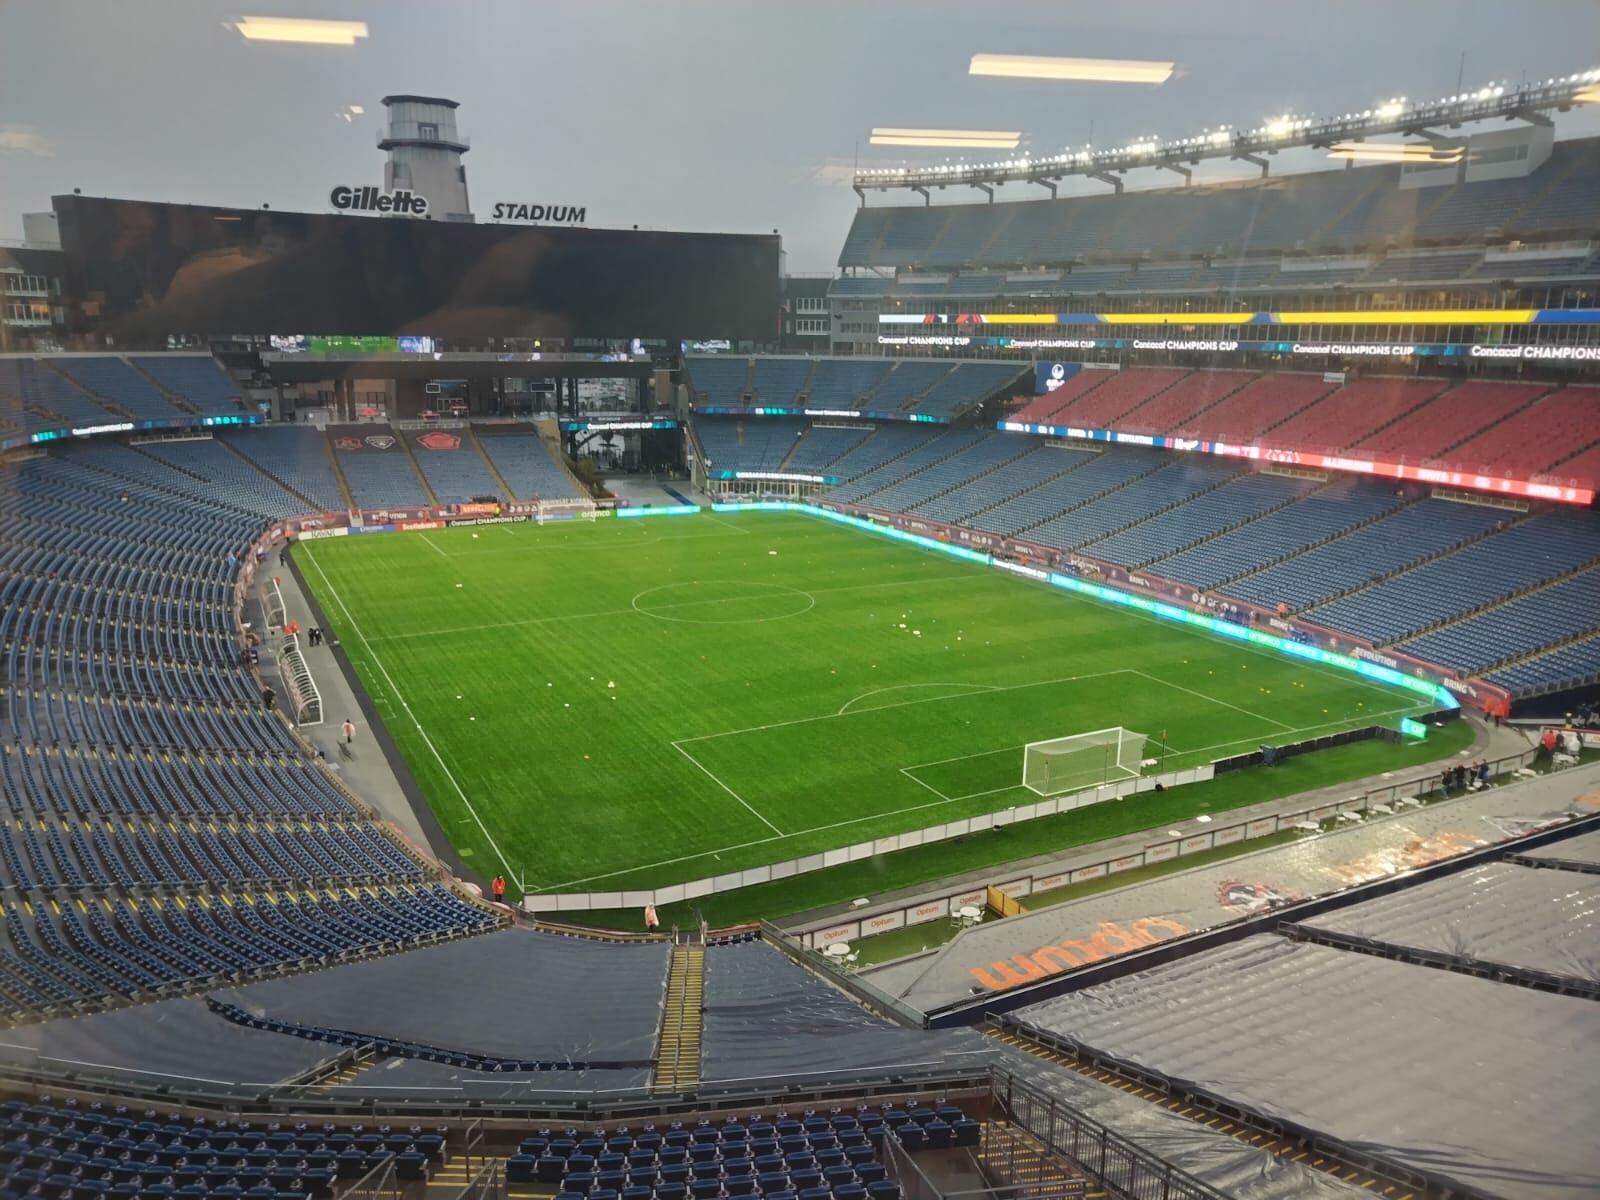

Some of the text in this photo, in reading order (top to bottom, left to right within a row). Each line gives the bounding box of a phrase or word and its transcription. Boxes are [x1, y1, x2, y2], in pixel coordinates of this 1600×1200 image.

[330, 185, 428, 215] Gillette
[492, 202, 586, 223] STADIUM
[1167, 341, 1218, 350] CHAMPIONS
[1219, 342, 1239, 351] CUP
[1331, 345, 1391, 355] CHAMPIONS
[1392, 346, 1415, 356] CUP
[1471, 345, 1522, 357] Concacaf
[916, 905, 939, 917] Optum
[871, 917, 895, 929] Optum
[823, 928, 849, 940] Optum
